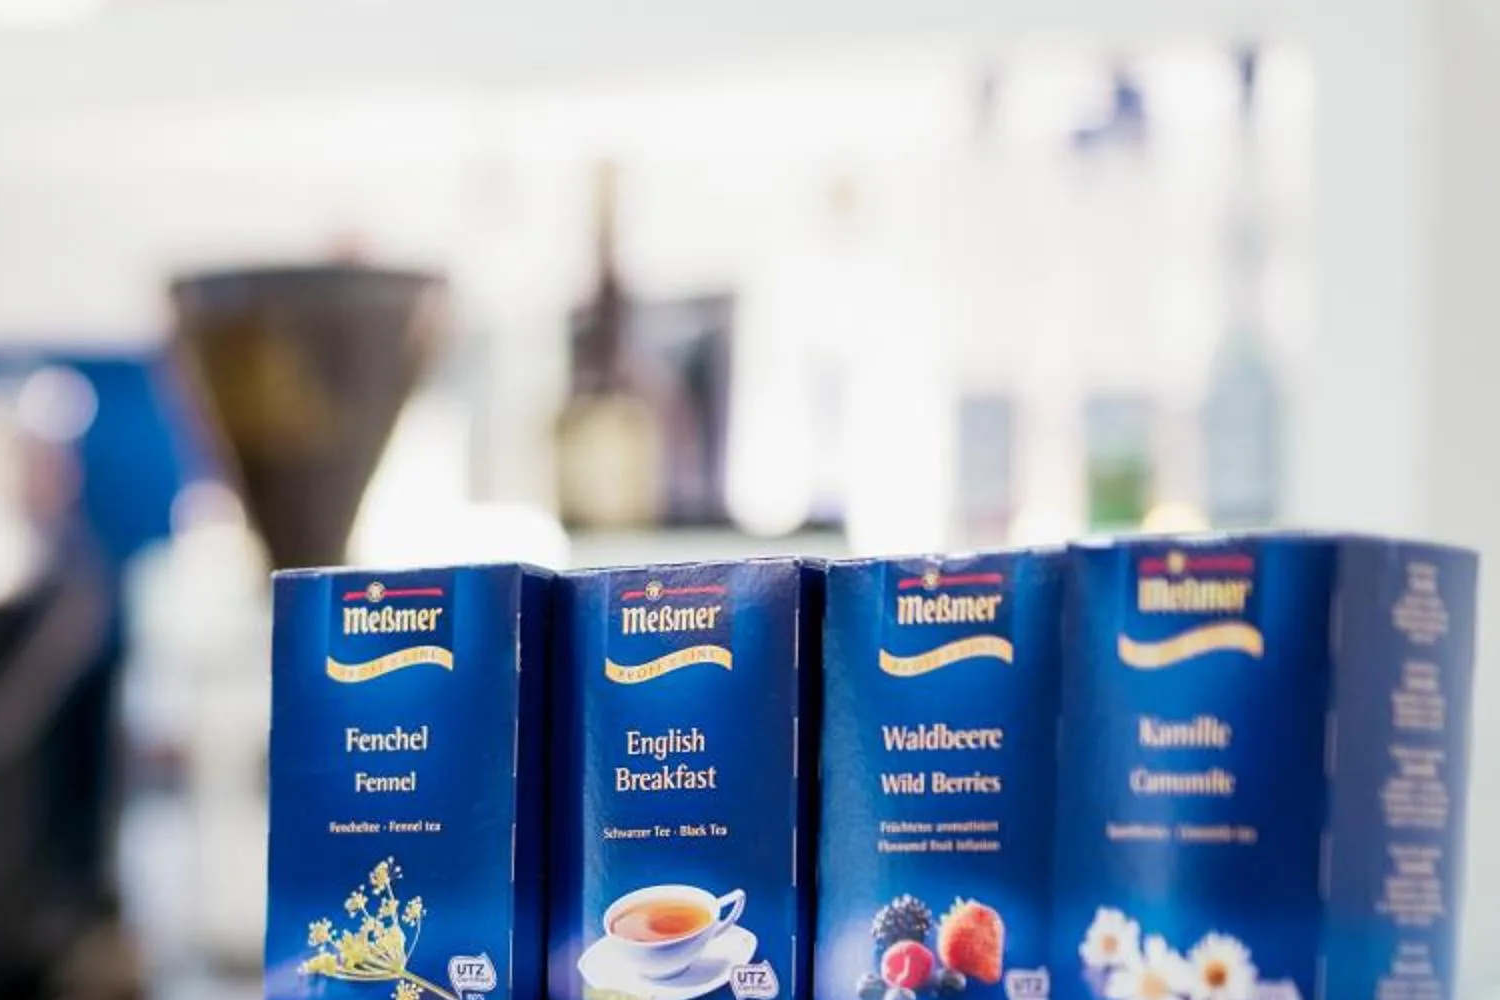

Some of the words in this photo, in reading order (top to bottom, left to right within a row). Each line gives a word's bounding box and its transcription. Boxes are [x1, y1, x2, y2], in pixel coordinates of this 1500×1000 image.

[343, 606, 443, 634] Meßmer
[622, 606, 722, 635] Meßmer
[898, 594, 1003, 625] Meßmer
[345, 726, 428, 752] Fenchel
[626, 728, 705, 760] English
[882, 723, 1003, 751] Waldbeere
[355, 771, 416, 793] Fennel
[615, 763, 717, 792] Breakfast
[881, 772, 925, 794] Wild
[932, 772, 1001, 793] Berries
[654, 825, 671, 837] Tee
[709, 823, 727, 836] Tea
[457, 963, 485, 976] UTZ
[737, 971, 767, 984] UTZ
